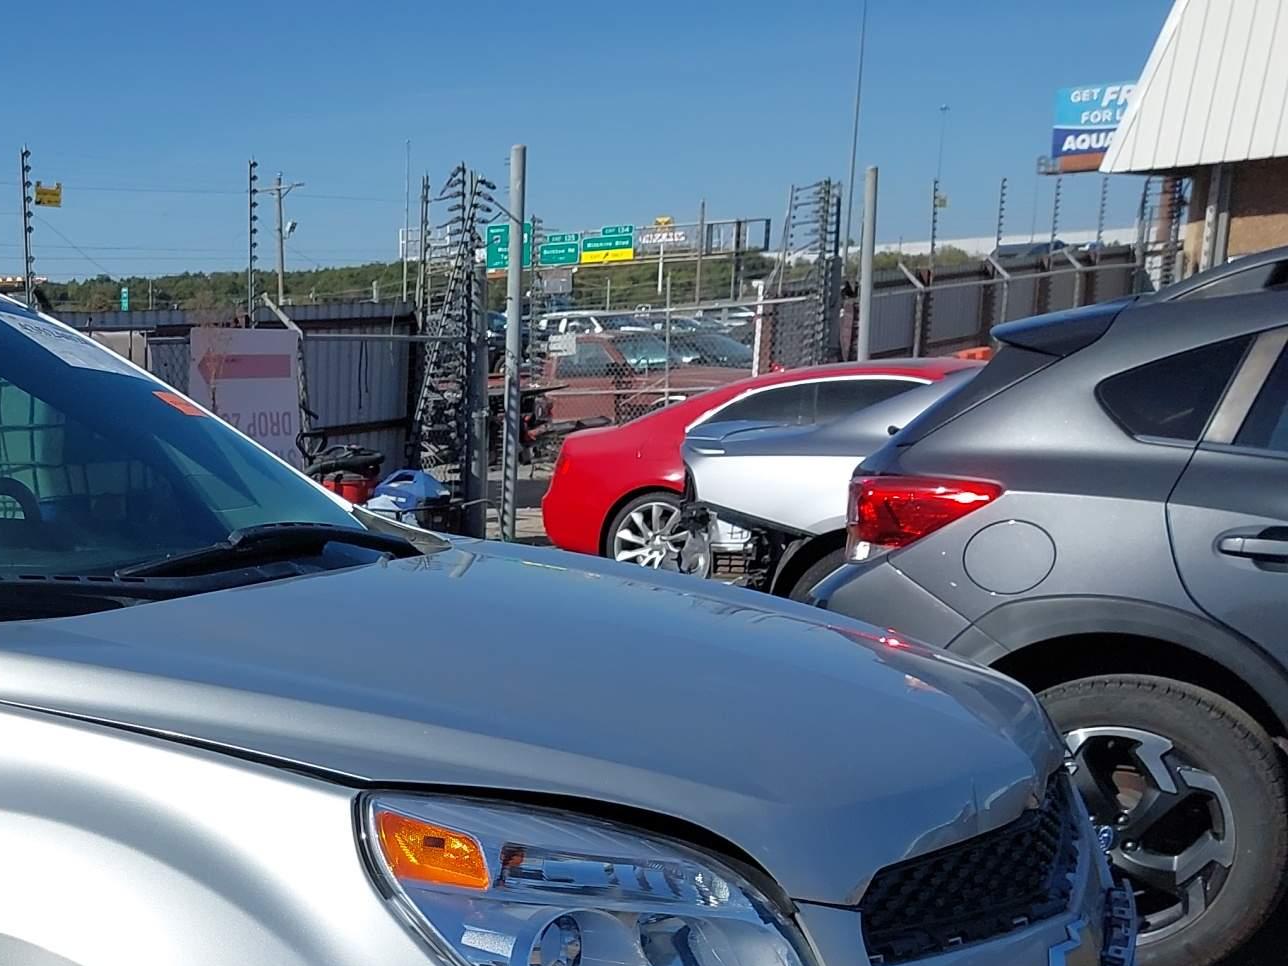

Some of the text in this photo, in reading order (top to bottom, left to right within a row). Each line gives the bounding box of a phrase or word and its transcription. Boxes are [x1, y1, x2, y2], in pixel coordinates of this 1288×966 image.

[1070, 88, 1101, 103] GET
[1081, 109, 1112, 124] FOR
[247, 411, 292, 438] DROP
